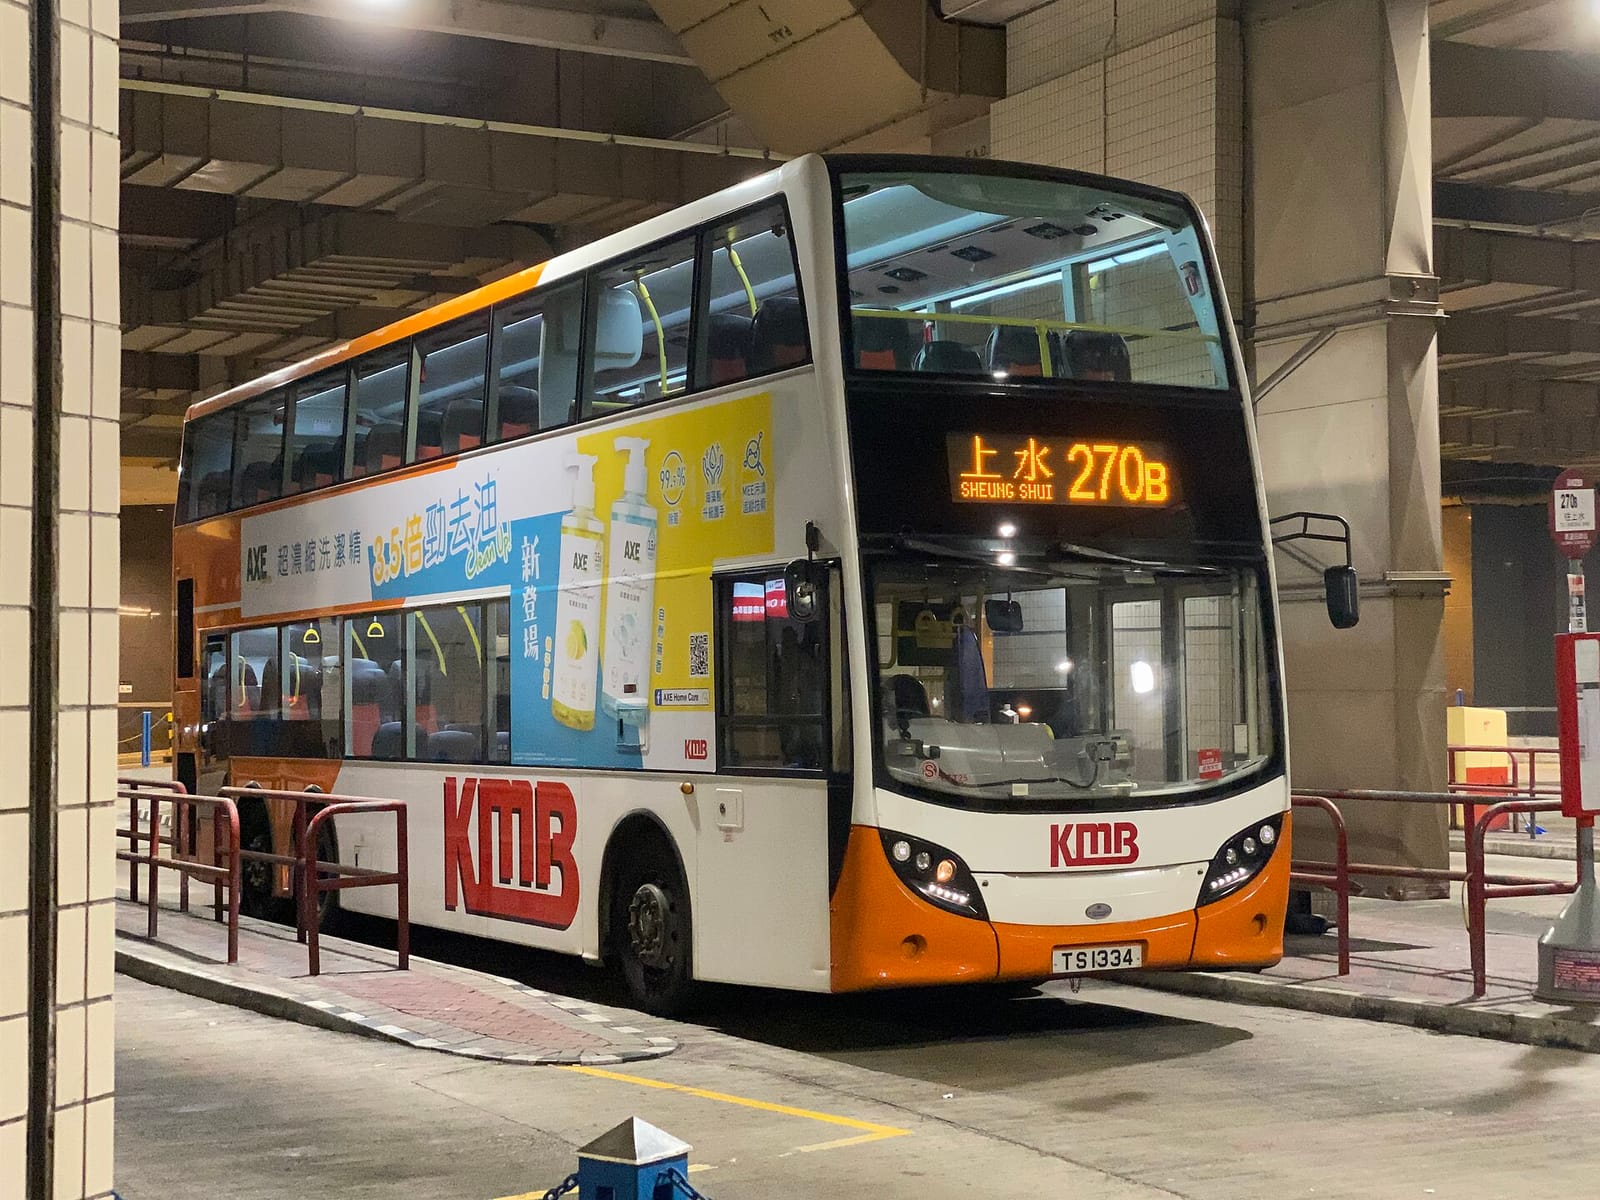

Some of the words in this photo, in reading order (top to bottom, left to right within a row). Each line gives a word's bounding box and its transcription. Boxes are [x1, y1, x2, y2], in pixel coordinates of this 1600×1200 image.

[960, 435, 1054, 481] 上水
[1066, 443, 1169, 501] 270B
[960, 481, 1015, 498] SHEUNG
[1019, 483, 1053, 500] SHUI
[373, 472, 497, 586] 3.5倍勁去油
[246, 545, 268, 582] AXE
[573, 552, 589, 571] AXE
[623, 540, 641, 561] AXE
[521, 535, 541, 661] 新登場
[664, 693, 673, 702] AXE
[674, 693, 687, 702] Home
[688, 693, 699, 702] Care
[684, 739, 708, 760] KMB
[444, 777, 580, 931] KMB
[1050, 822, 1139, 868] KMB
[1061, 948, 1133, 970] TS1334
